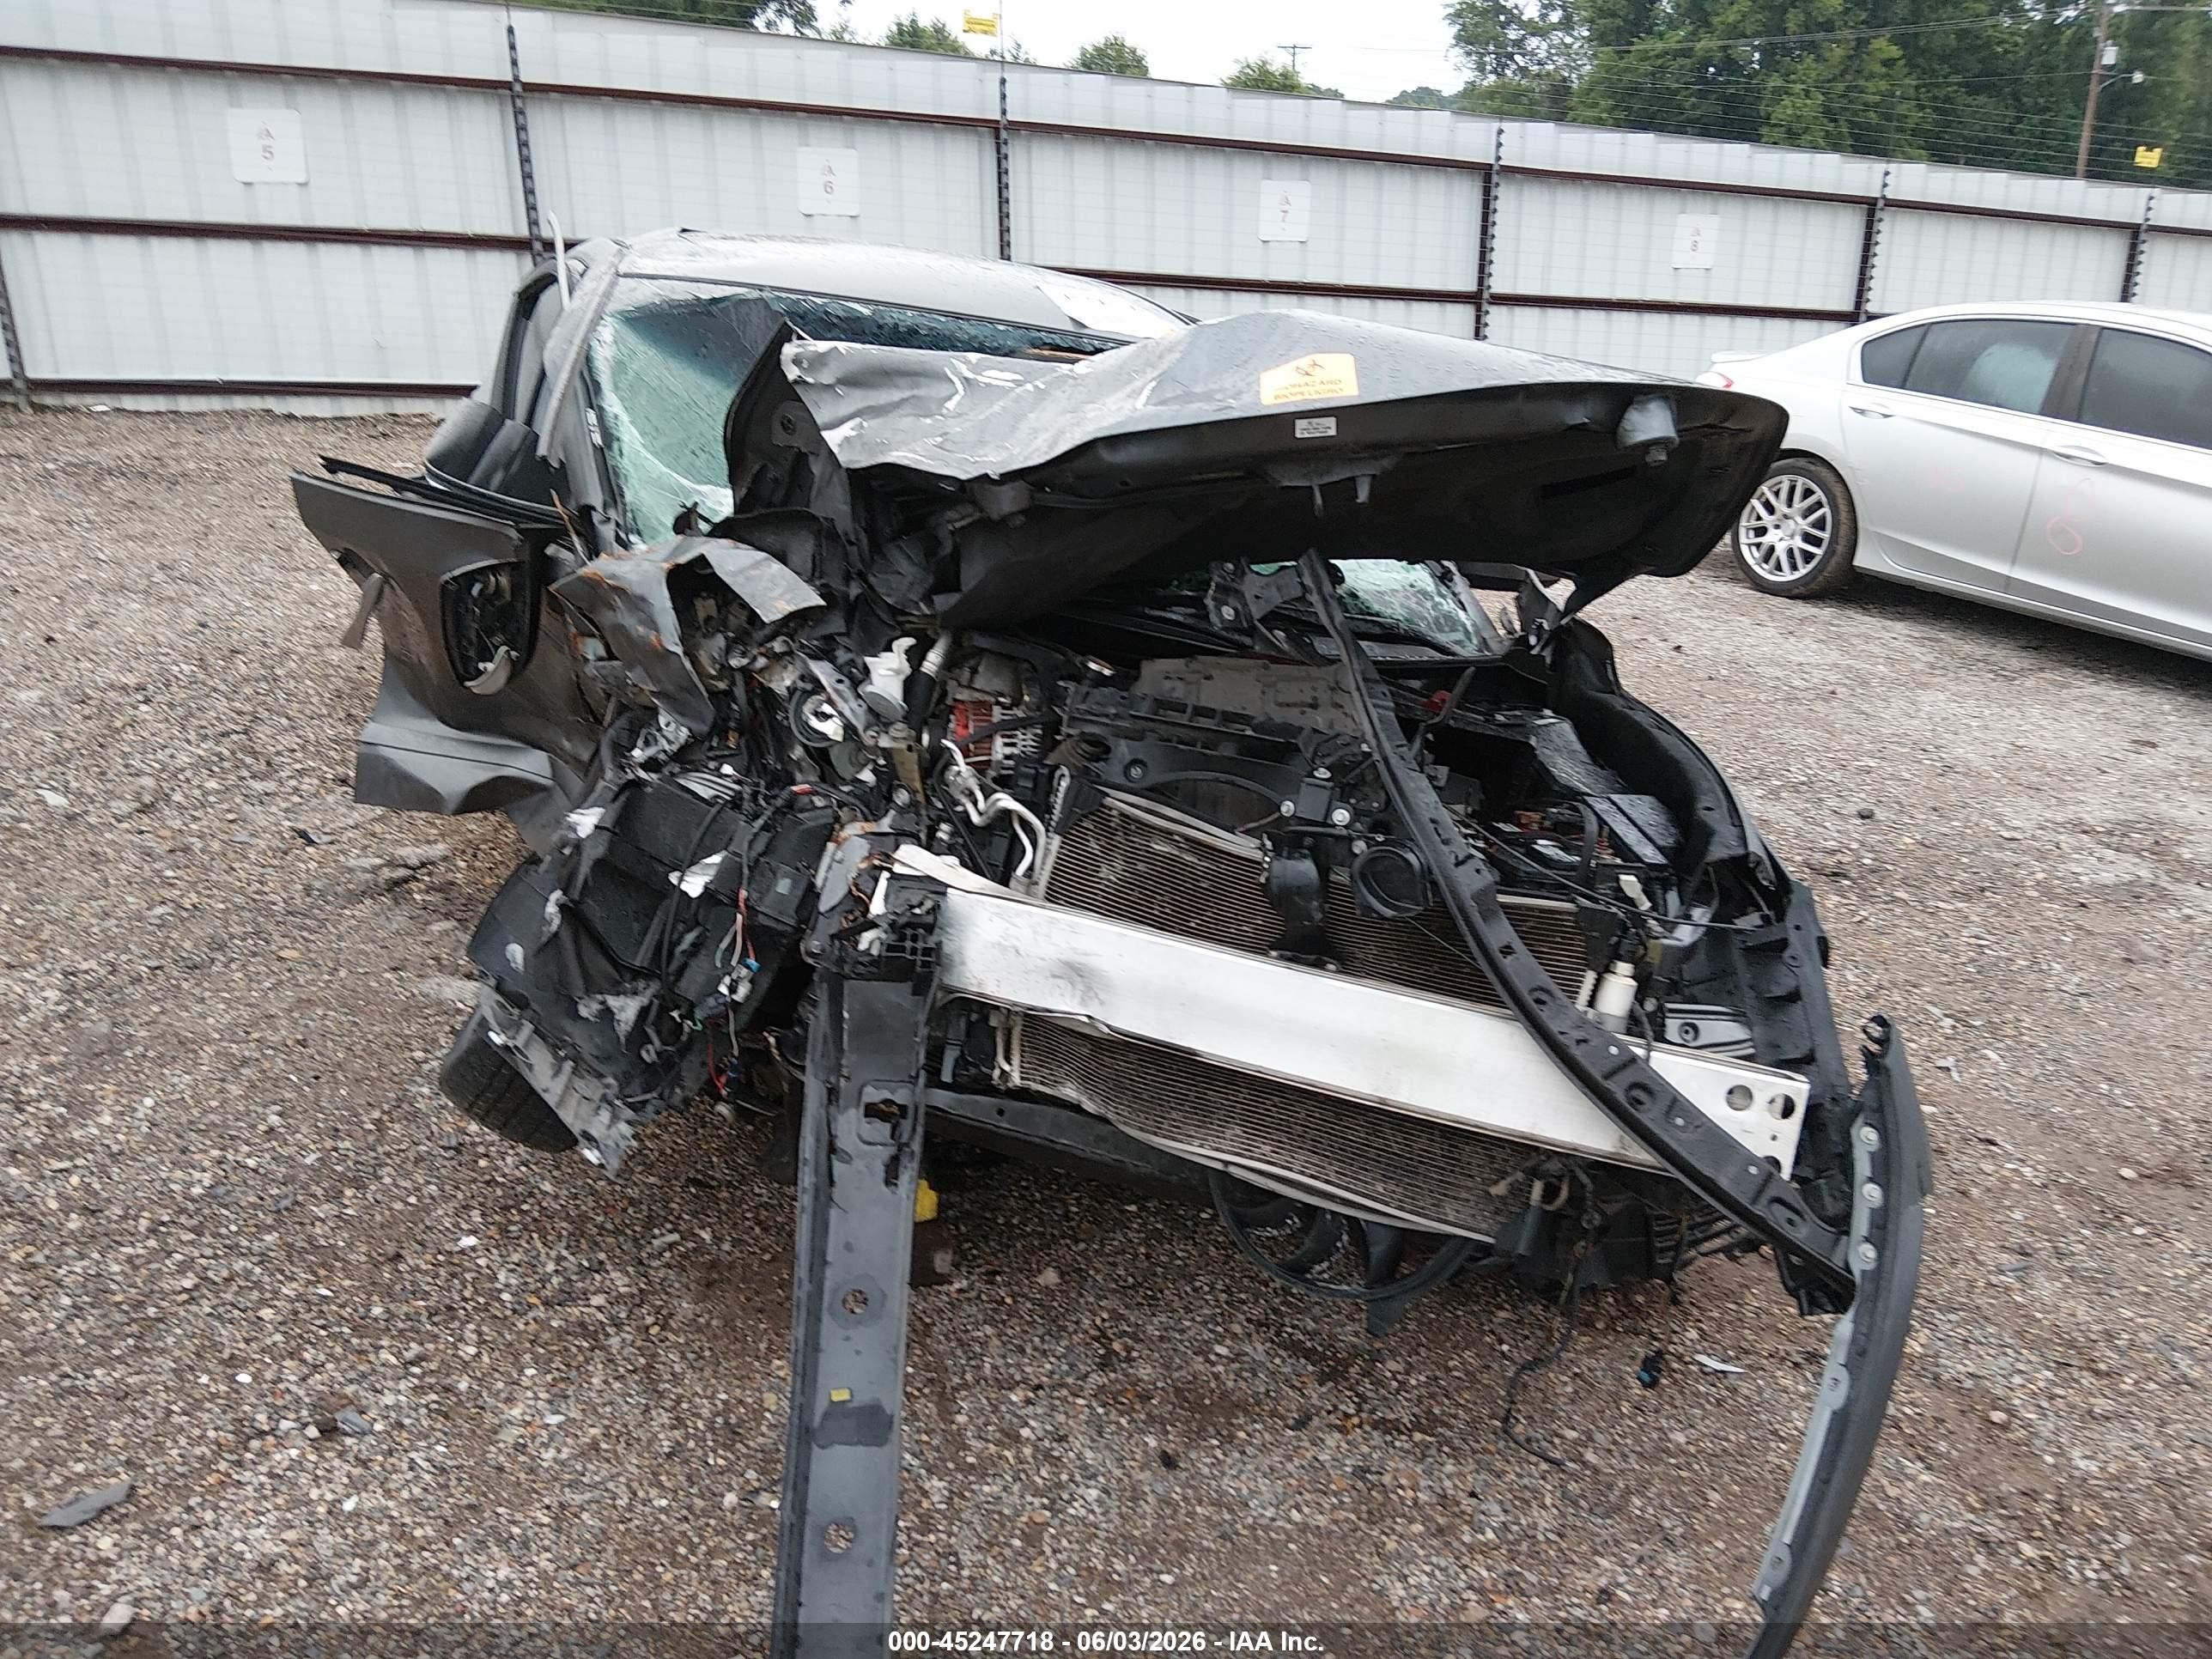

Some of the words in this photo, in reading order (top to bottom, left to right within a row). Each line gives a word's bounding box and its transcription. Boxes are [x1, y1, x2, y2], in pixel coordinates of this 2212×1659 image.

[261, 143, 275, 161] 5
[823, 180, 835, 195] 6
[1279, 210, 1290, 223] 7
[1690, 240, 1699, 252] 8
